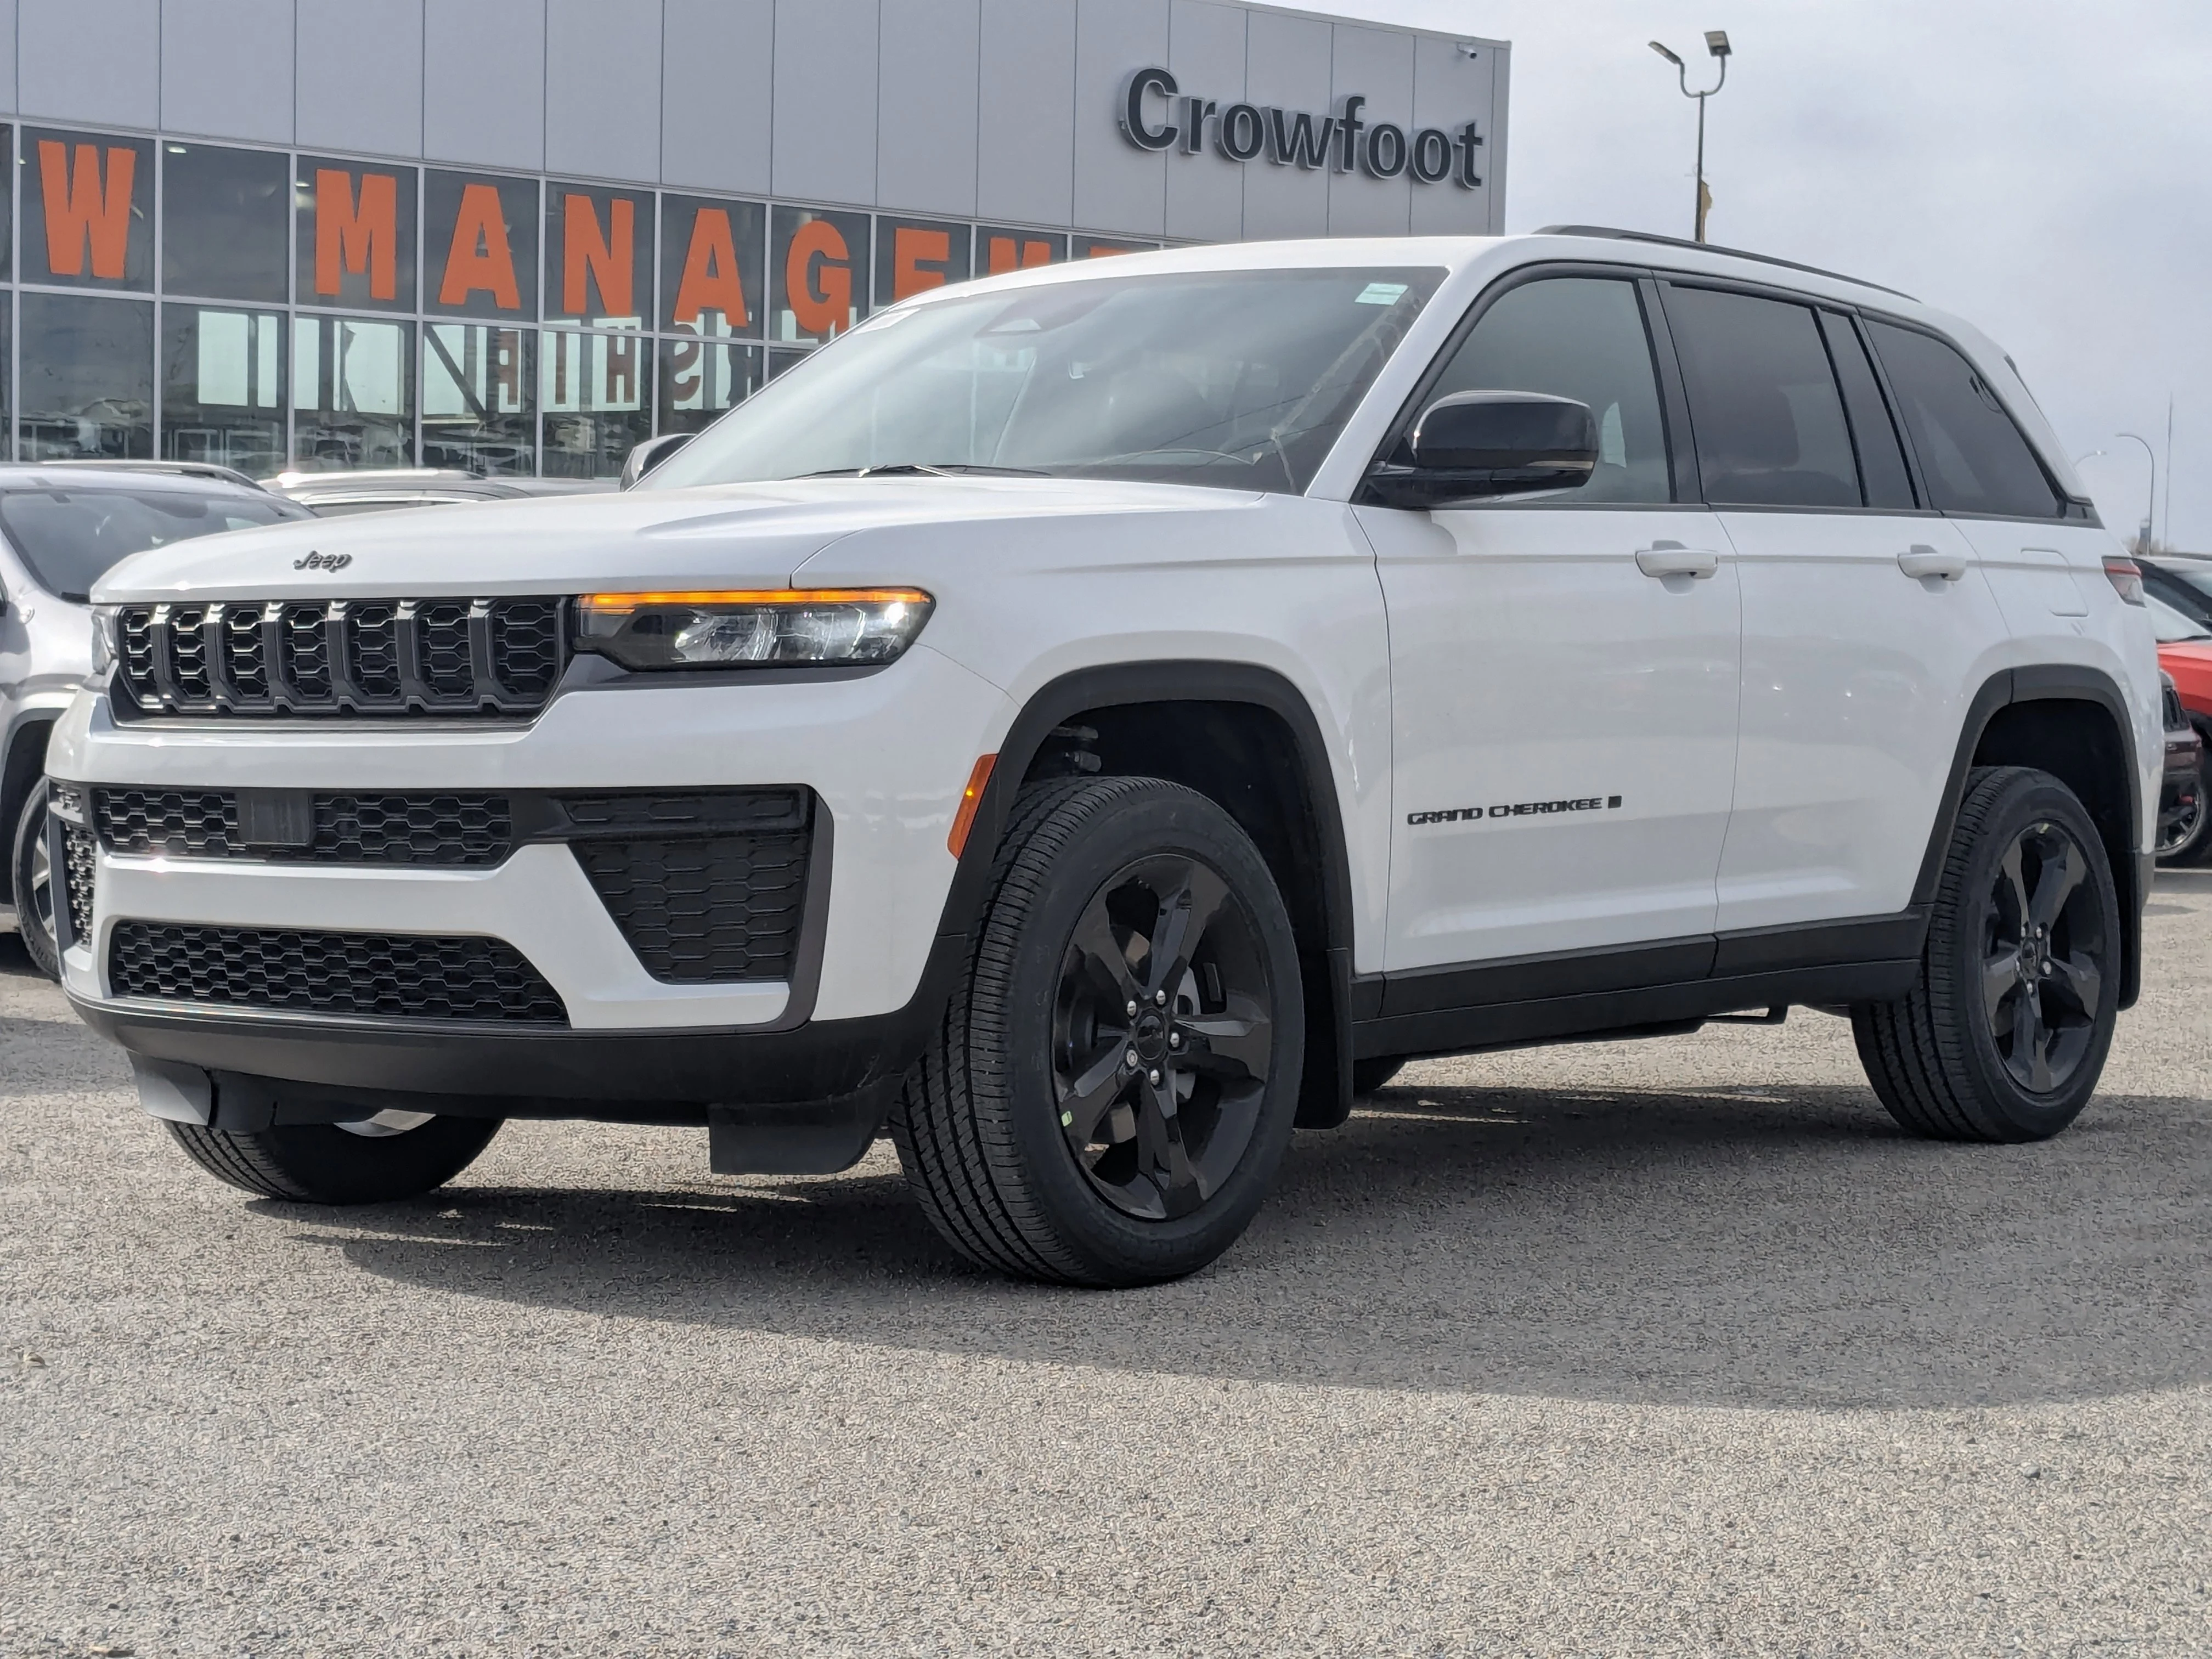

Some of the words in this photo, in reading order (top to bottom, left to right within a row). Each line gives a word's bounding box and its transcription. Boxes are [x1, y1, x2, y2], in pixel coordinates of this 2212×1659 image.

[1120, 66, 1483, 190] Crowfoot
[293, 550, 352, 573] Jeep
[1407, 808, 1483, 825] GRAND
[1488, 798, 1602, 817] CHEROKEE
